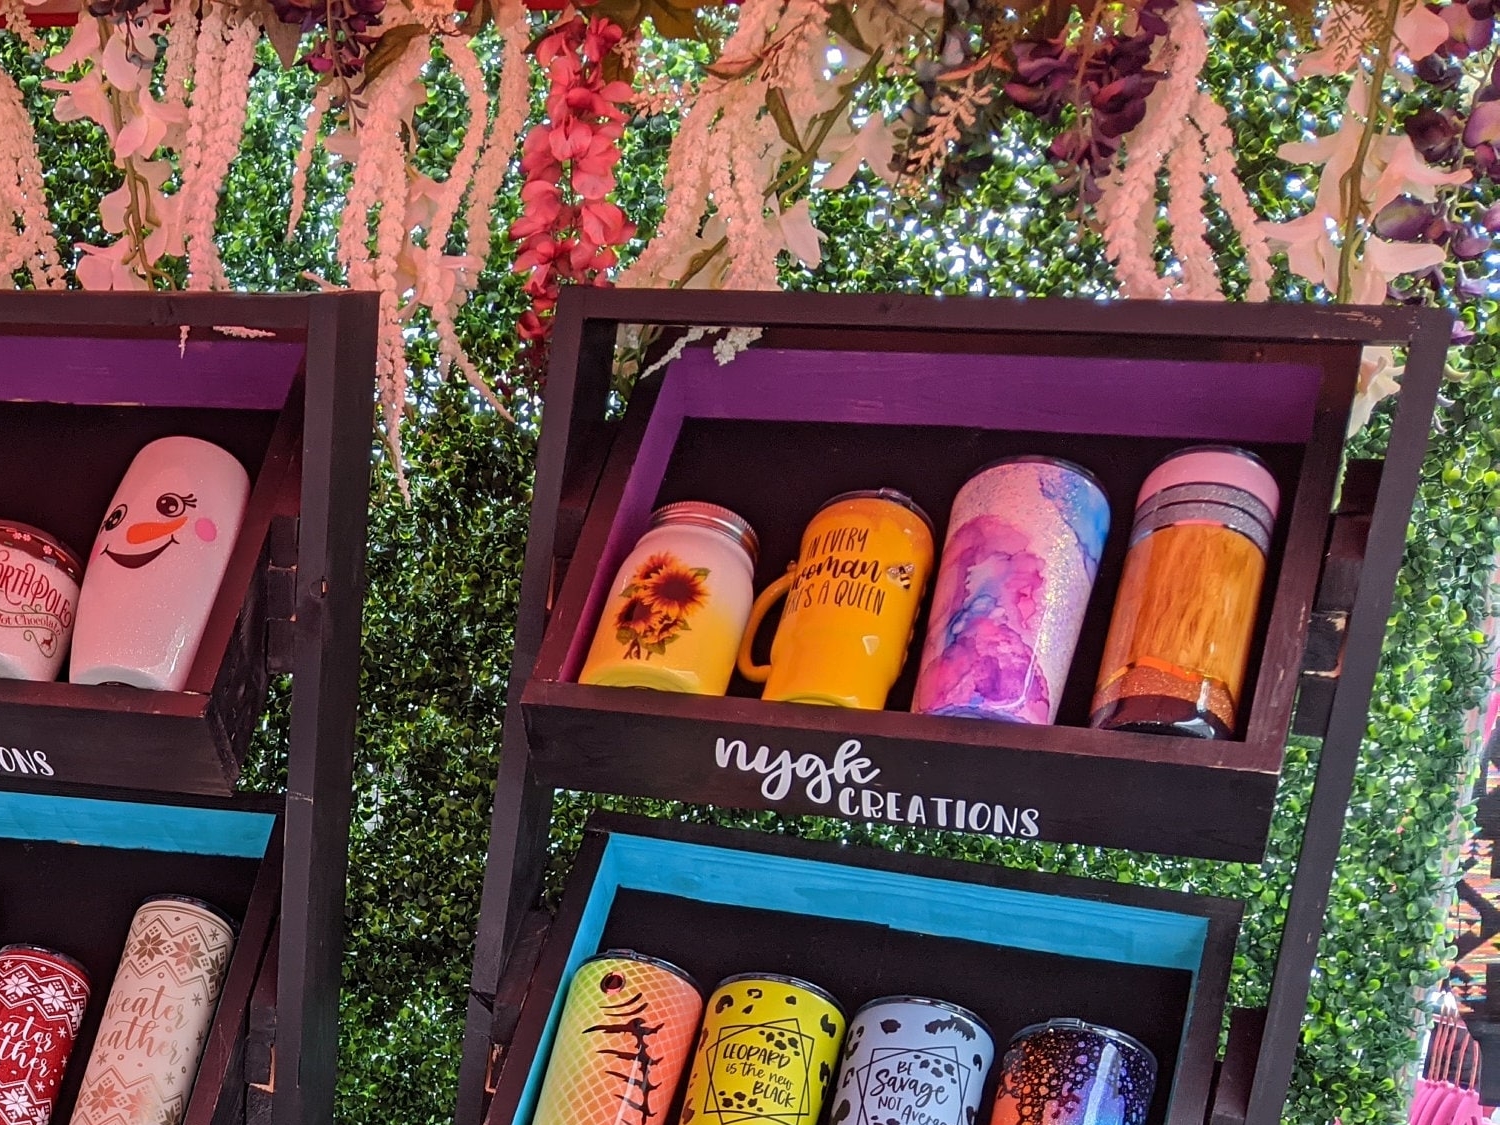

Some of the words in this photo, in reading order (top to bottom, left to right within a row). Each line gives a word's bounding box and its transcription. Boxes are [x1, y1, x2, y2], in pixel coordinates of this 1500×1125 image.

[806, 534, 821, 562] IN
[822, 527, 869, 555] EVERY
[791, 555, 882, 591] woman
[30, 574, 72, 629] POLE
[818, 579, 830, 605] A
[835, 579, 886, 616] QUEEN
[715, 738, 880, 804] nygk
[838, 787, 1039, 837] CREATIONS
[106, 985, 190, 1030] weater
[99, 1015, 183, 1066] eather
[723, 1043, 791, 1069] LEOPARD
[726, 1062, 738, 1075] is
[740, 1061, 765, 1078] the
[768, 1072, 794, 1091] new
[897, 1060, 915, 1076] BE
[752, 1080, 797, 1109] BLACK
[869, 1068, 950, 1108] Savage
[877, 1095, 904, 1112] NOT
